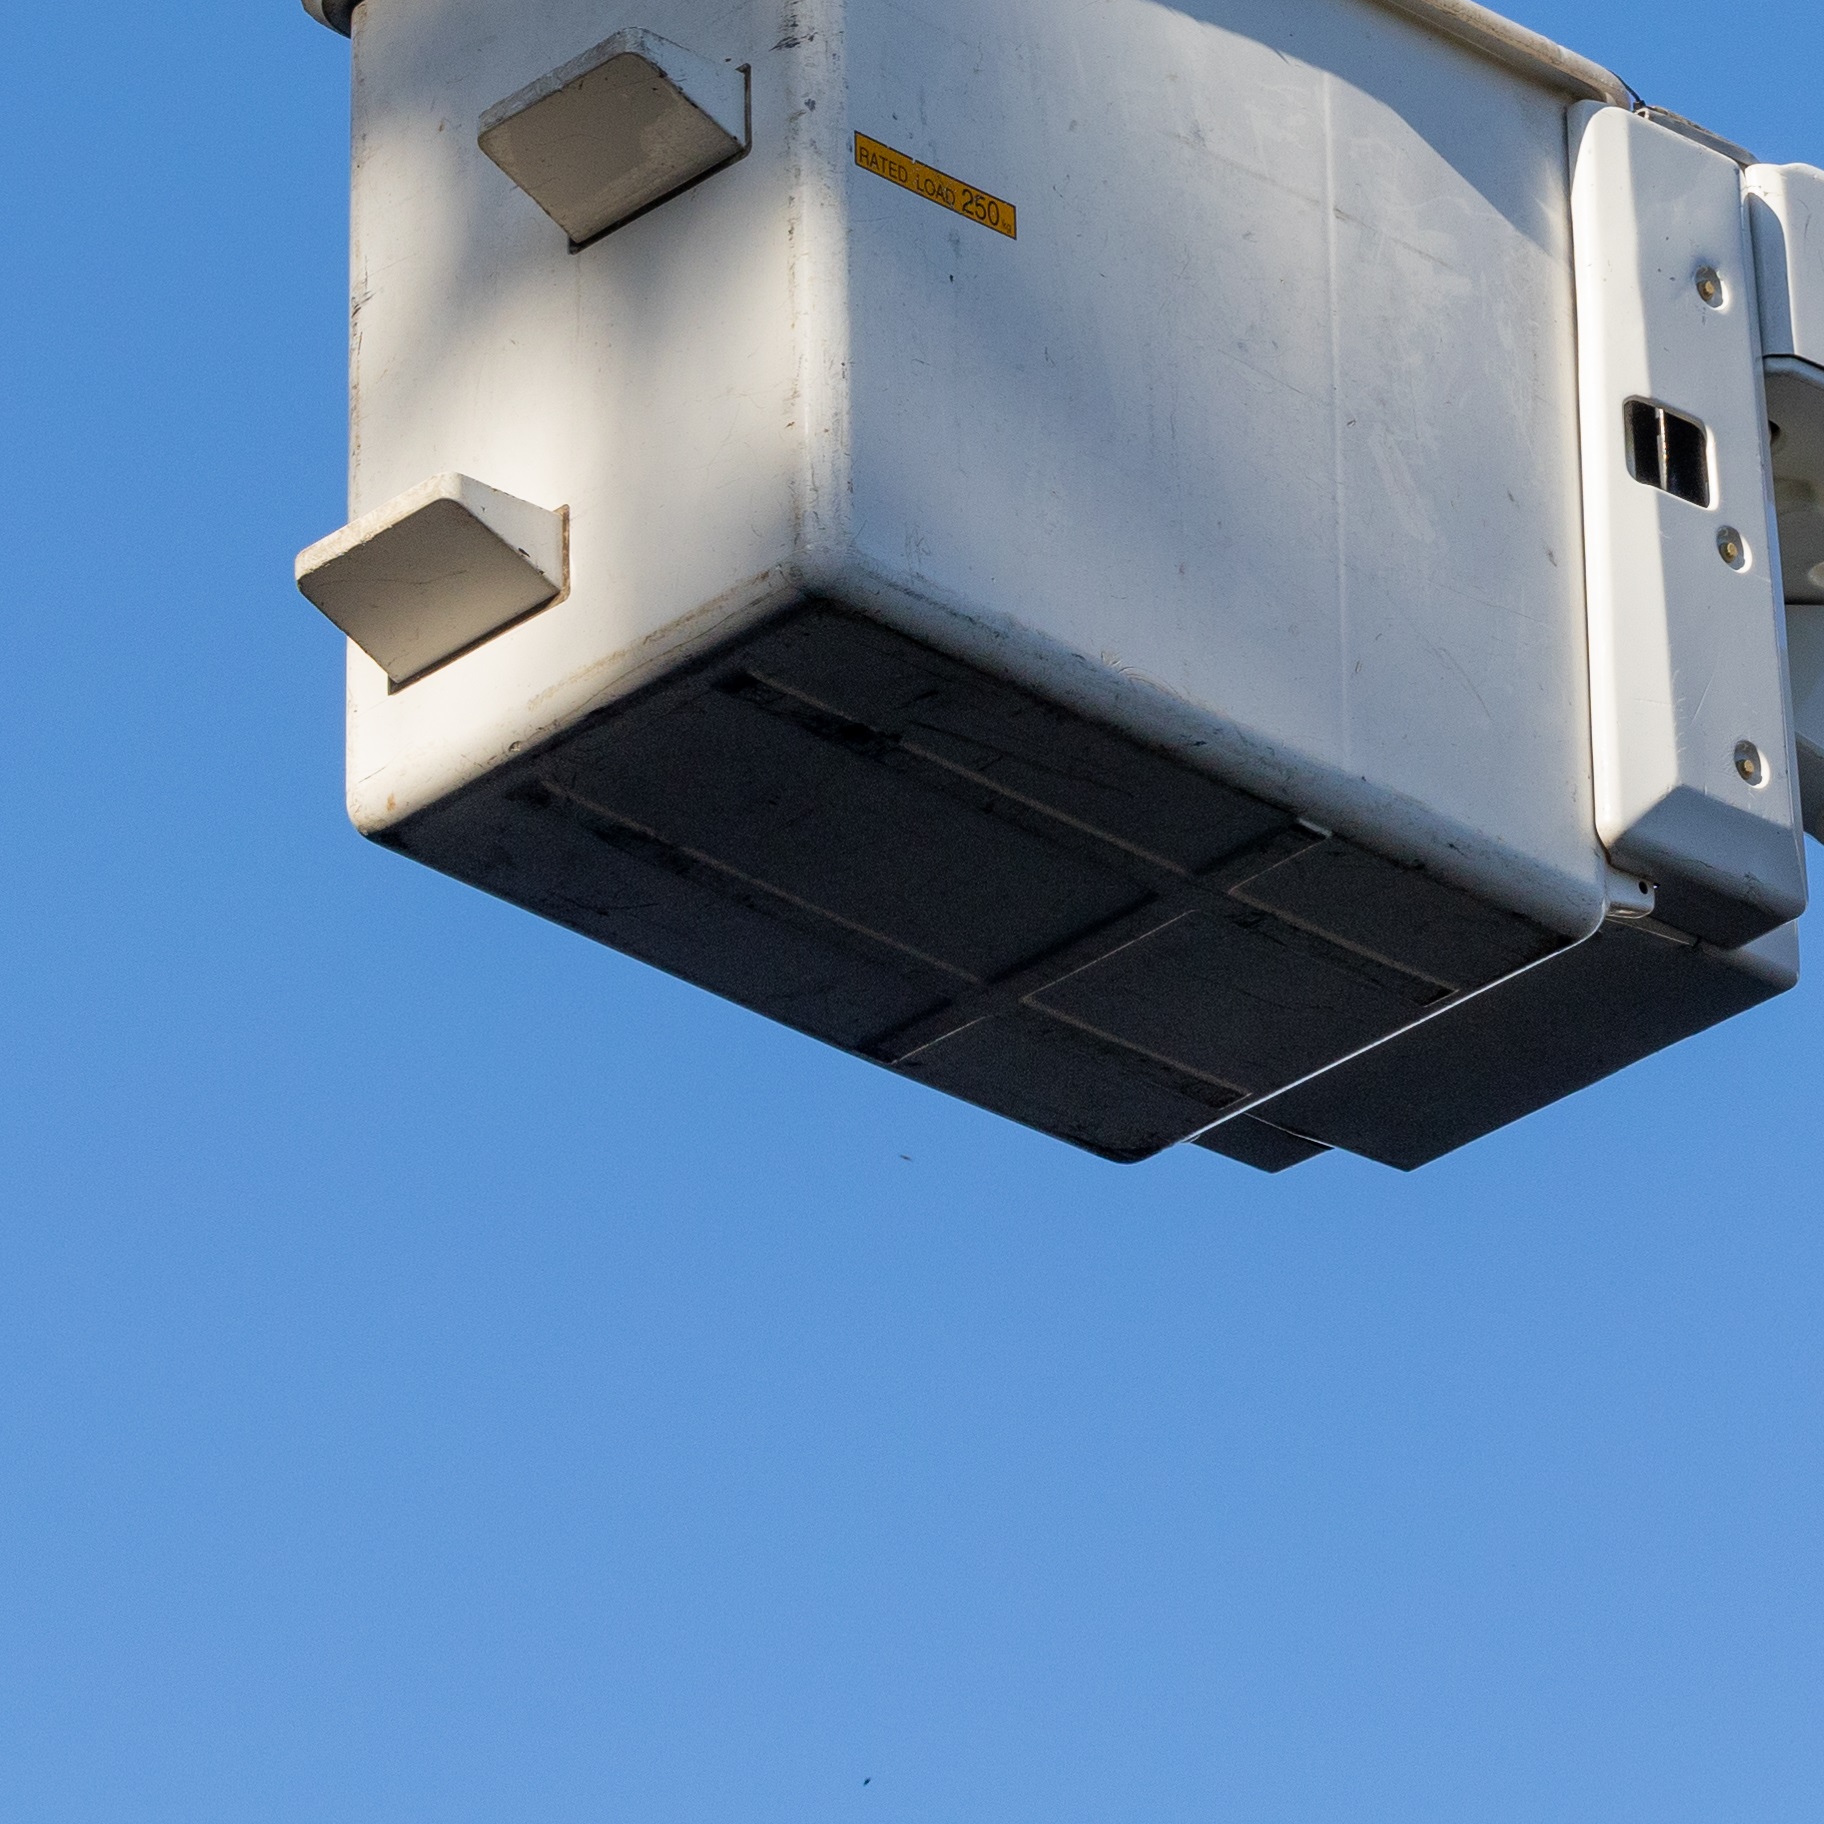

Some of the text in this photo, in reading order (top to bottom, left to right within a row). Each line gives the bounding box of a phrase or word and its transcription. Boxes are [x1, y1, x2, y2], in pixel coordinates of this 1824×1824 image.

[859, 146, 1012, 234] RATED LOAD 250 kg
